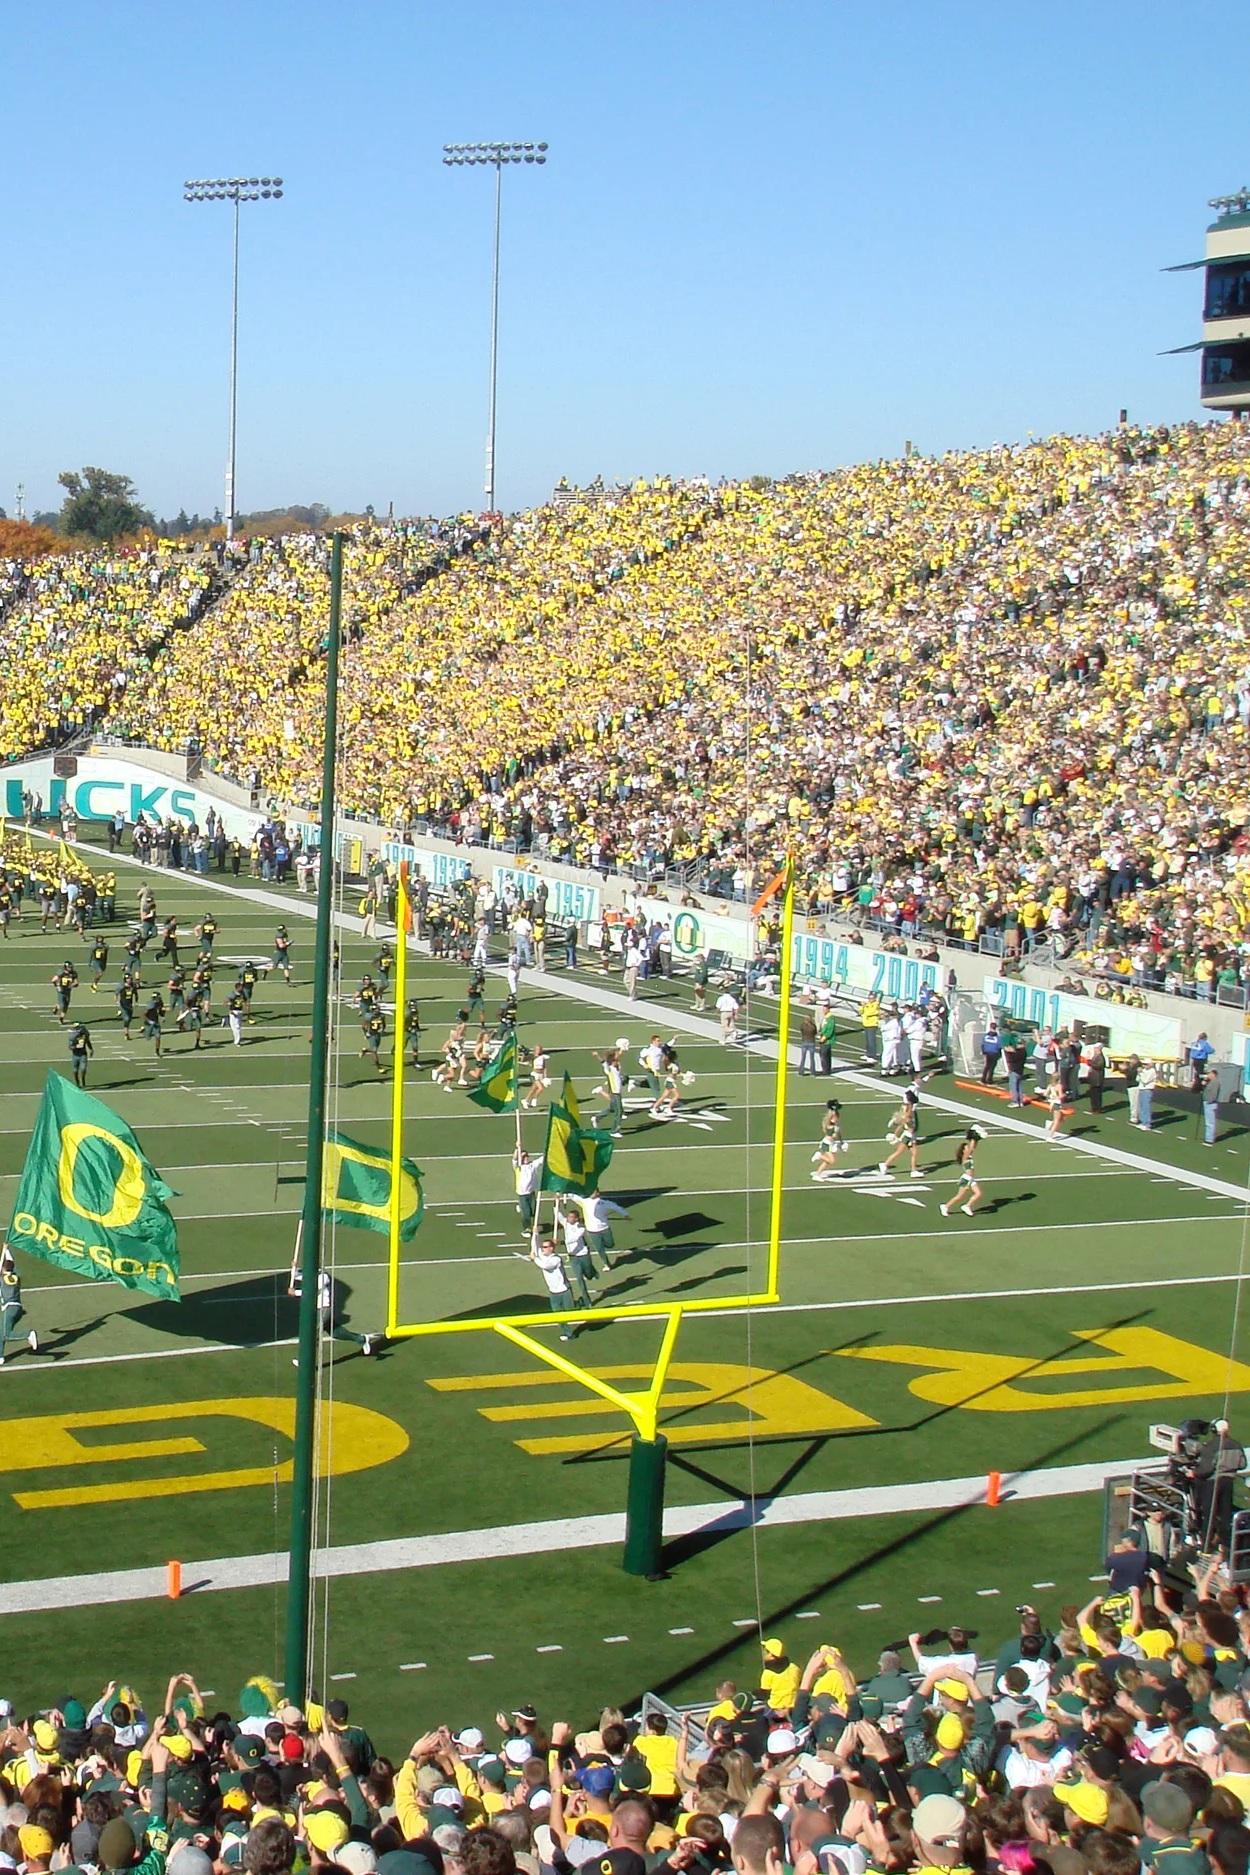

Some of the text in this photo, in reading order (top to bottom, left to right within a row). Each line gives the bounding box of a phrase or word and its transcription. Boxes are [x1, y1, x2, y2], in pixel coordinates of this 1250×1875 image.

[555, 881, 595, 921] 1957
[794, 935, 849, 985] 1994
[992, 979, 1060, 1035] 2001
[13, 1212, 177, 1285] OREGON
